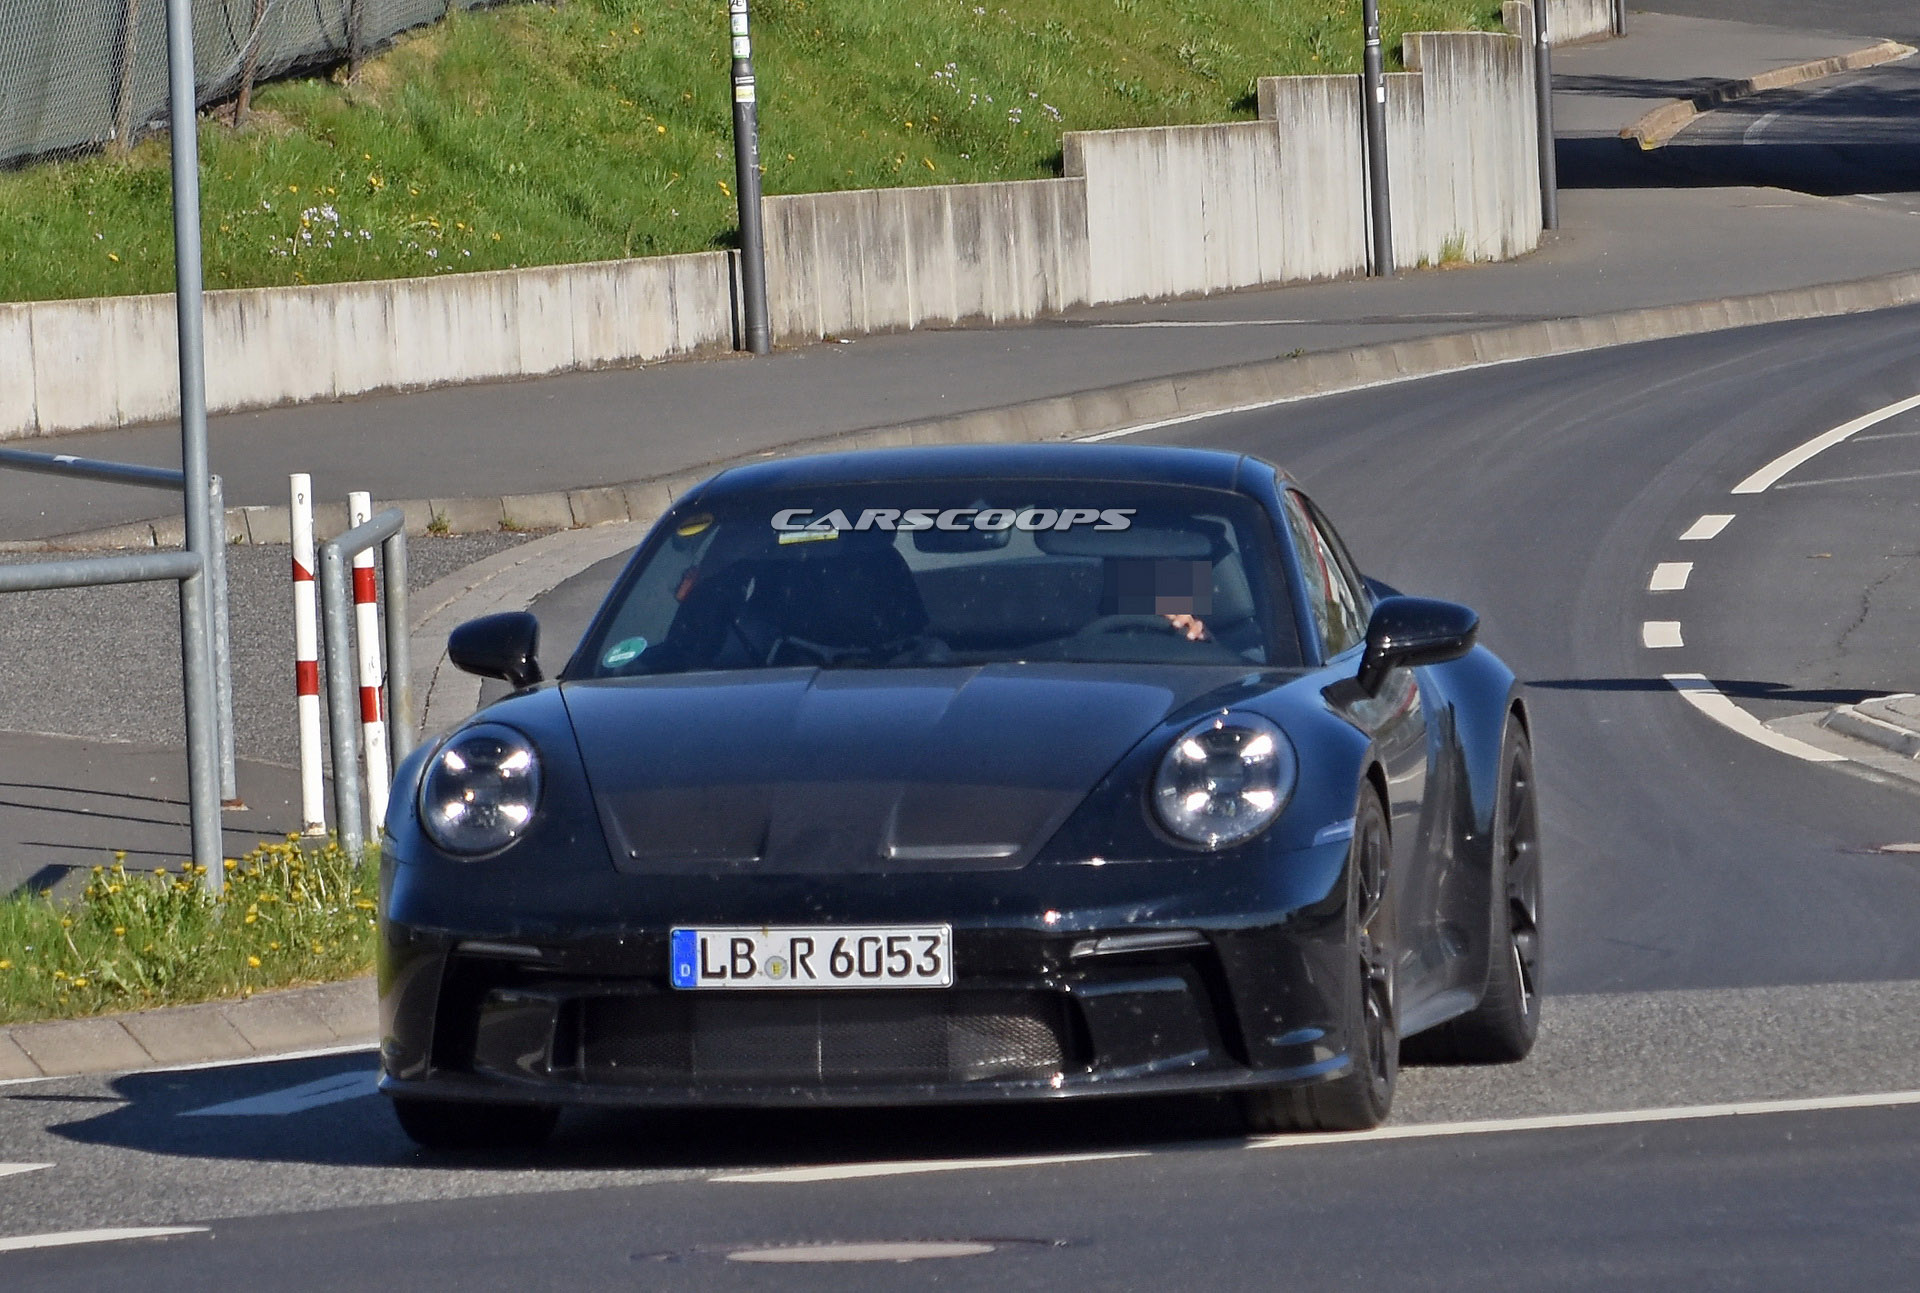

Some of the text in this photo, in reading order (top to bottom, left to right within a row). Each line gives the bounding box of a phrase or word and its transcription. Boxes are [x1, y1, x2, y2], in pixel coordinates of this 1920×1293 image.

[681, 964, 690, 977] D
[701, 936, 942, 979] LB R 6053
